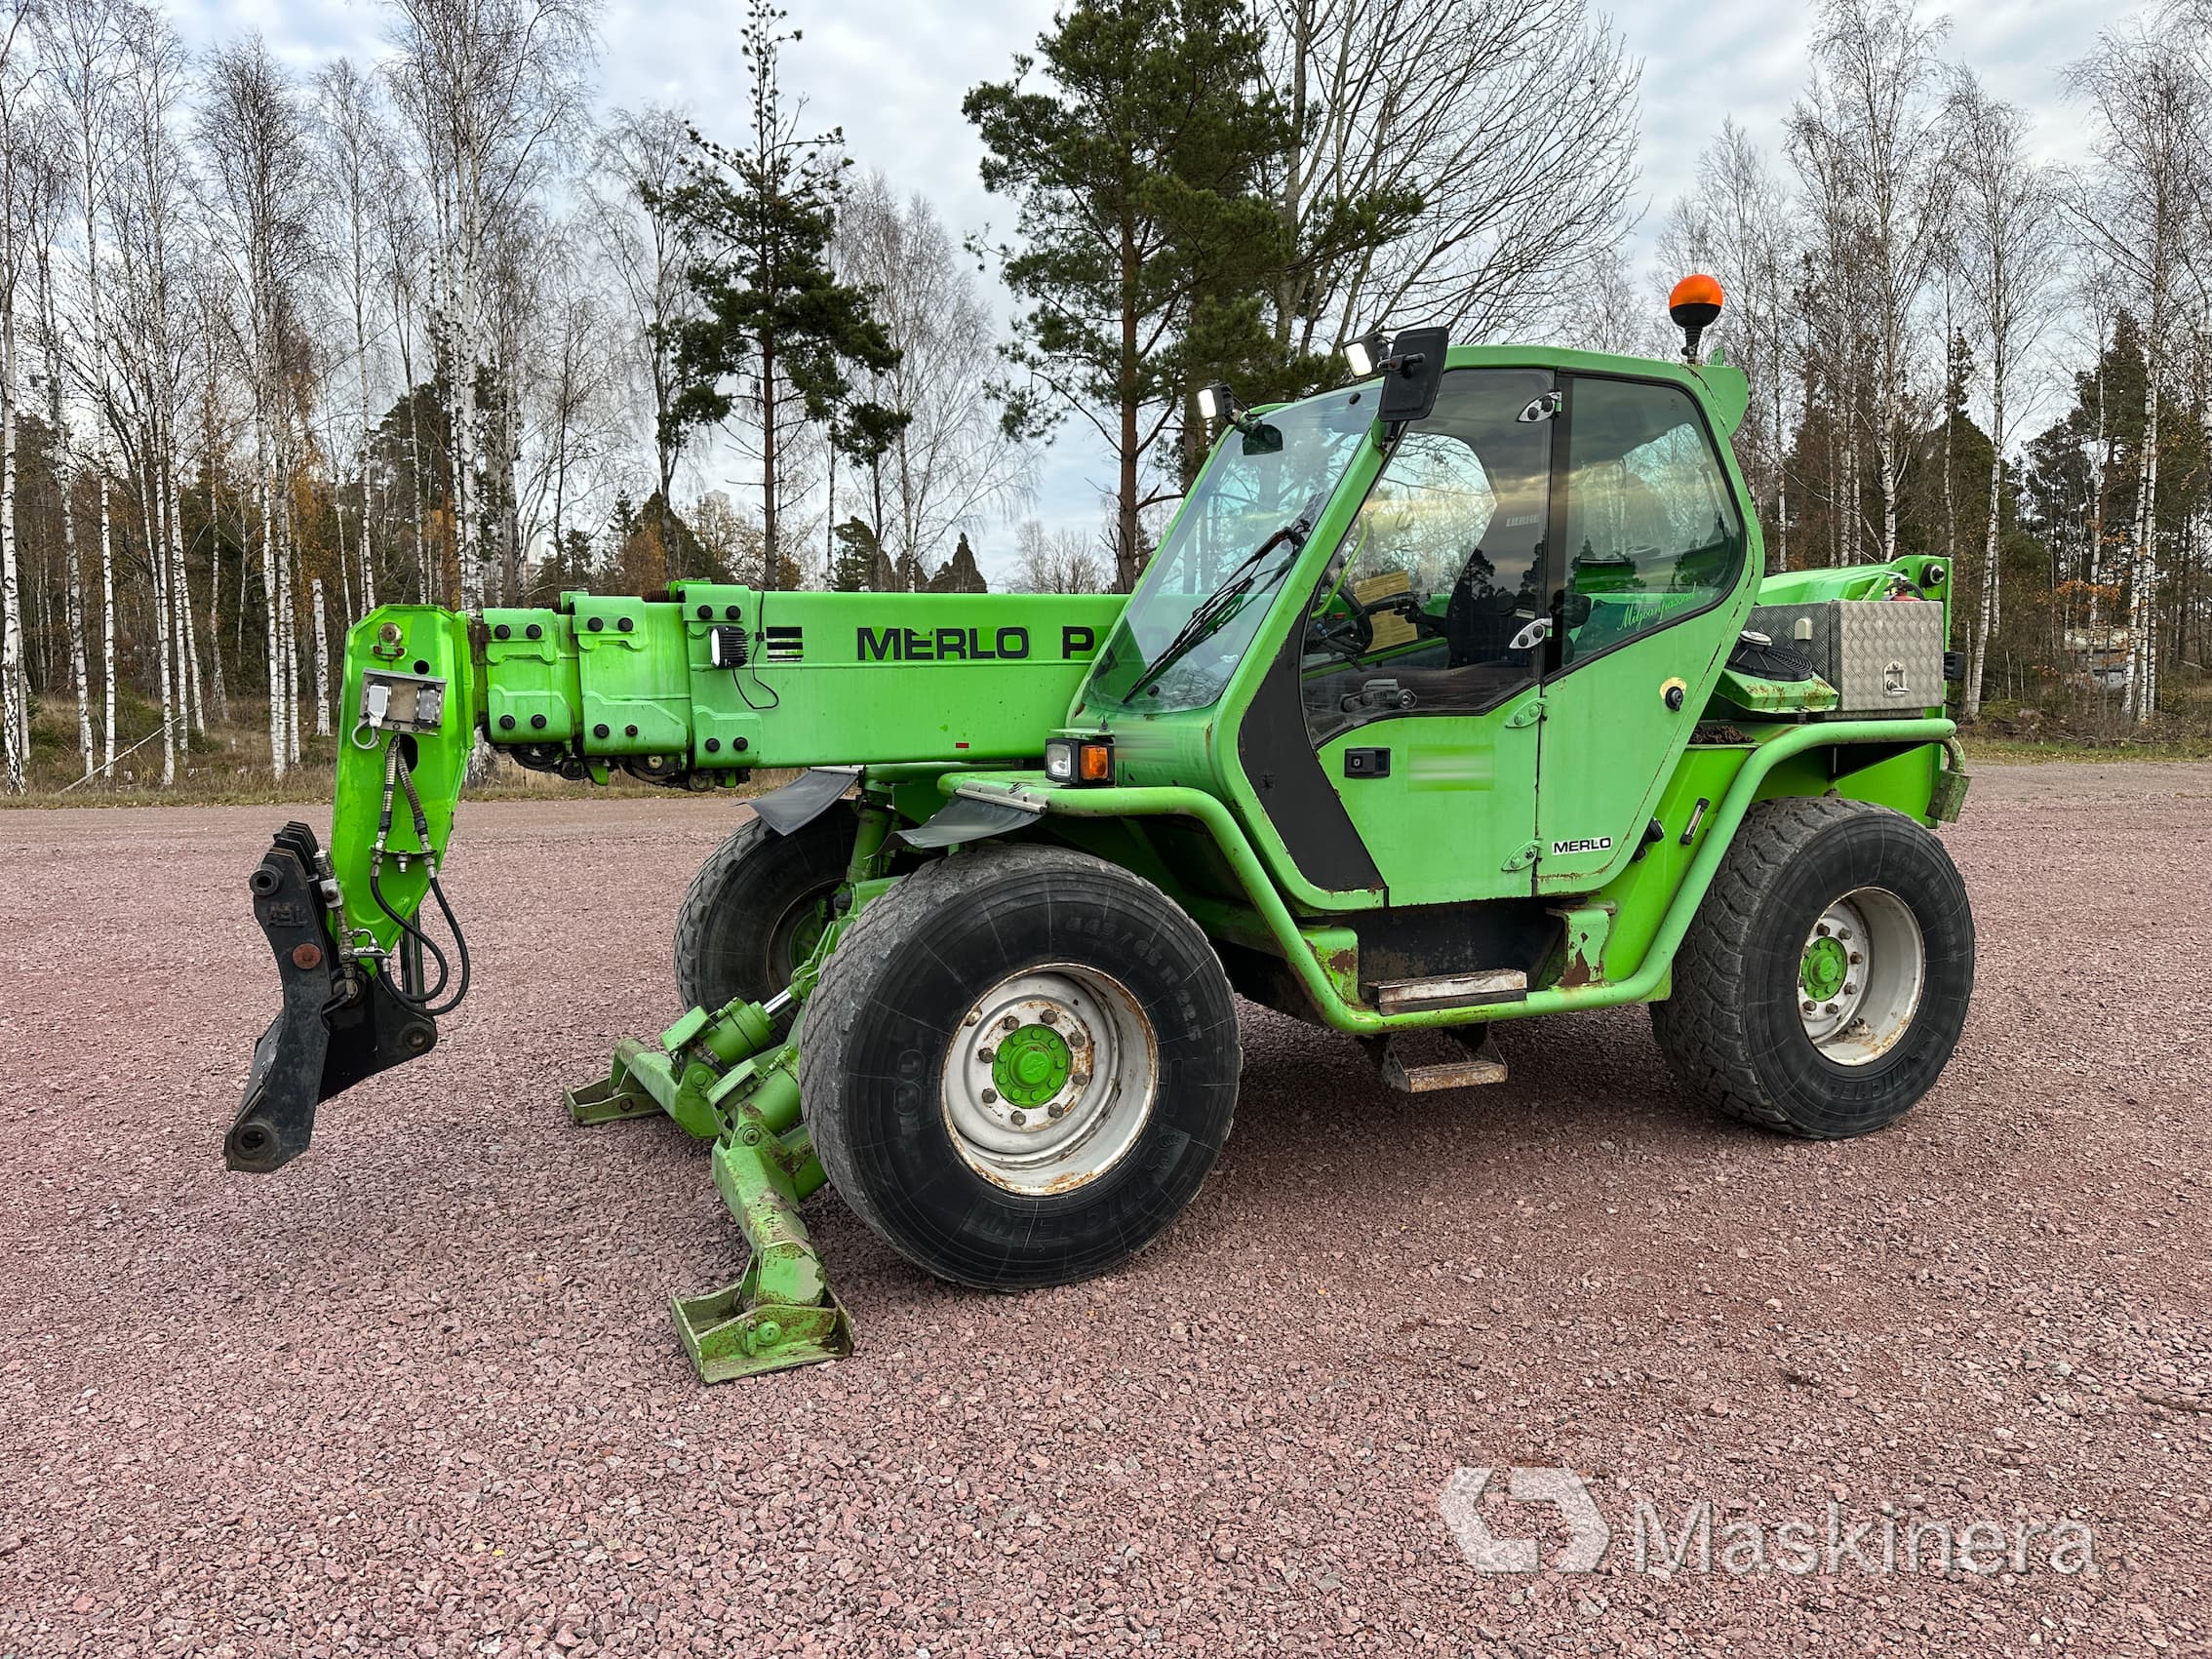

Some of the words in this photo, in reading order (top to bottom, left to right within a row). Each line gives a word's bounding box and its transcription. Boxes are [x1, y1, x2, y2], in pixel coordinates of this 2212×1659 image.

[856, 626, 1030, 661] MERLO
[1061, 625, 1095, 659] P
[1554, 837, 1611, 853] MERLO
